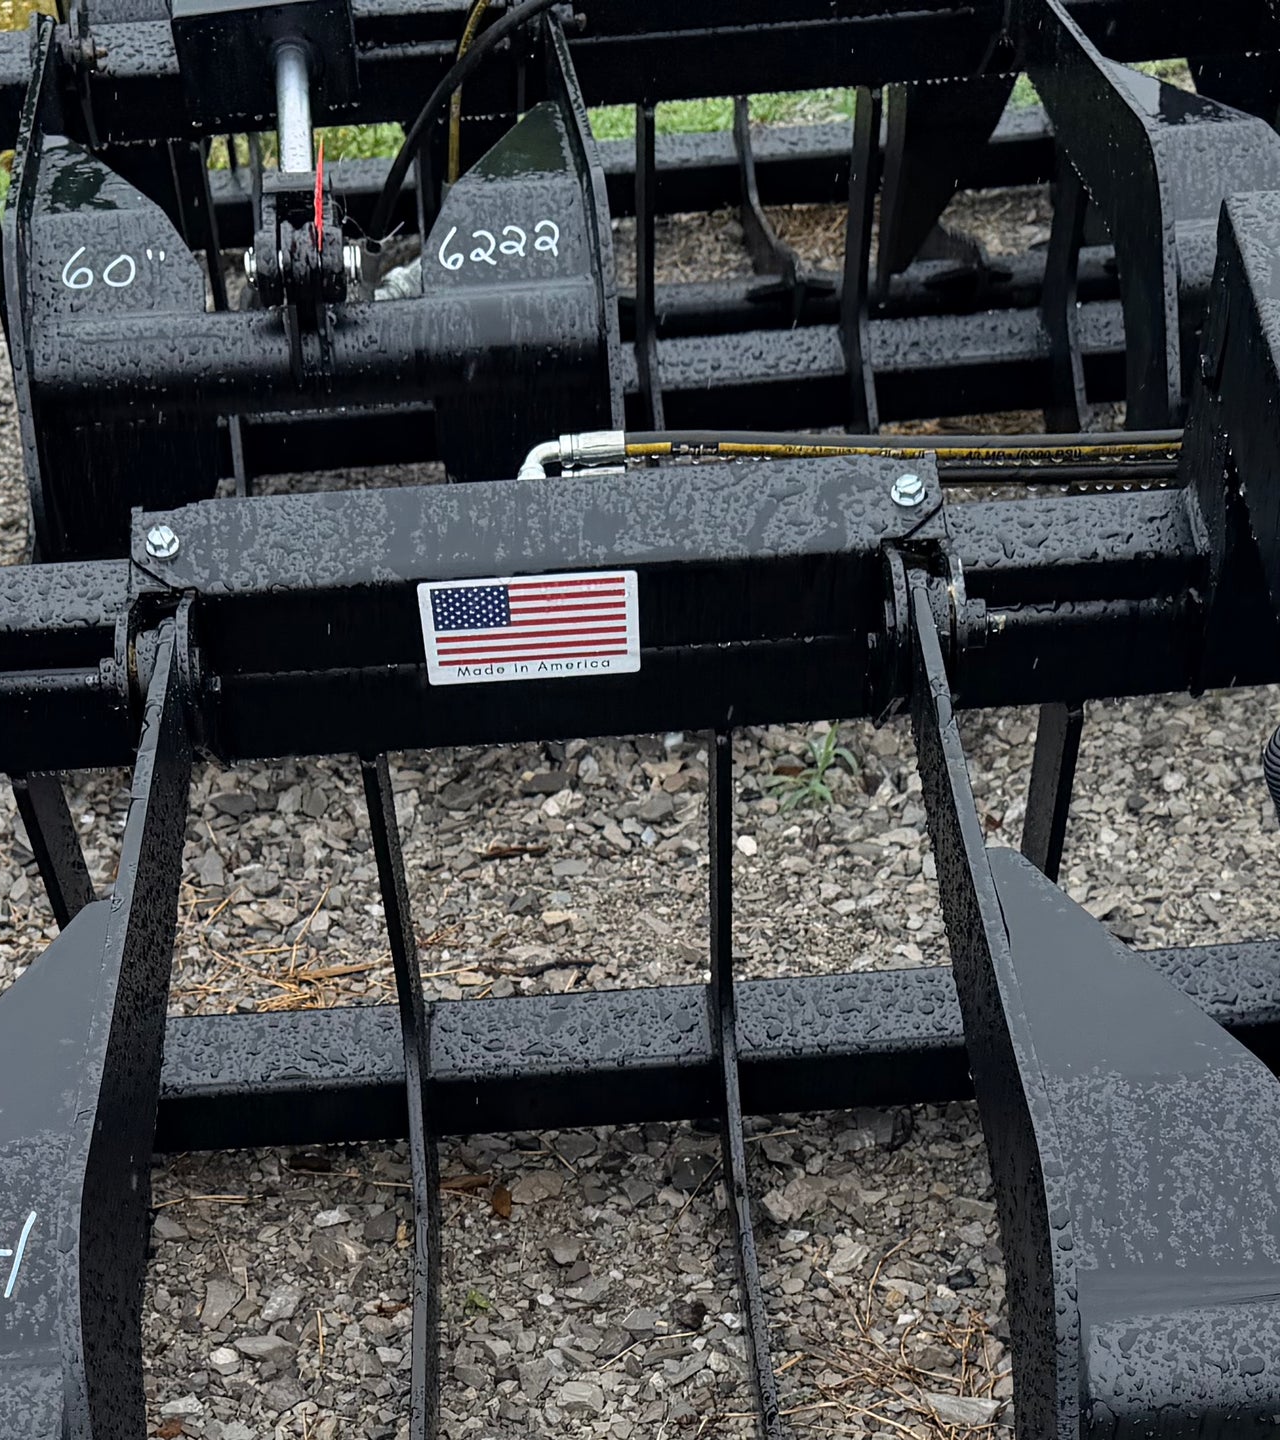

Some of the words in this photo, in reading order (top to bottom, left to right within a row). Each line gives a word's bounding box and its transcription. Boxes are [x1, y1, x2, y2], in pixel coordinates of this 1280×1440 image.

[437, 219, 560, 271] 6222
[61, 246, 167, 290] 60"
[456, 663, 506, 678] Made
[537, 658, 611, 673] America
